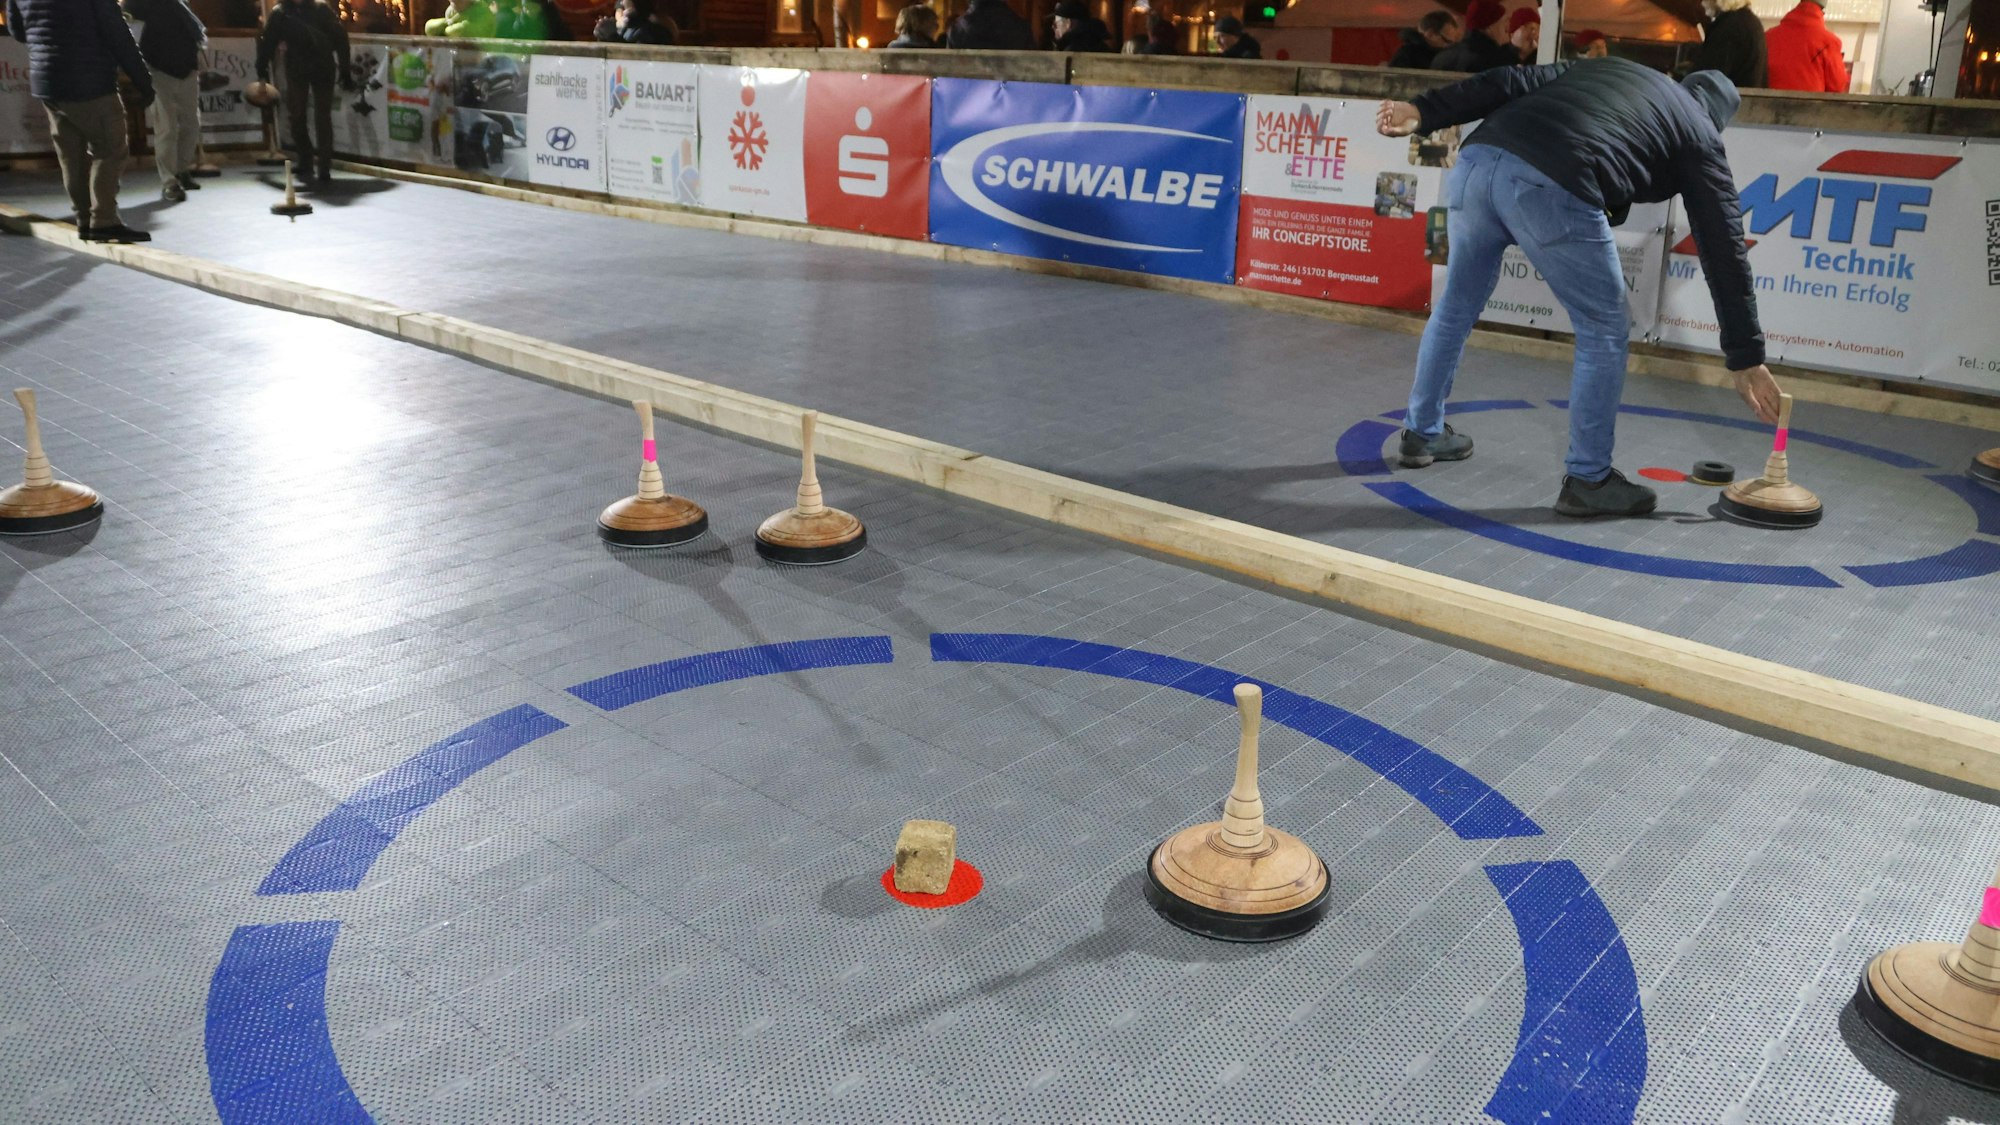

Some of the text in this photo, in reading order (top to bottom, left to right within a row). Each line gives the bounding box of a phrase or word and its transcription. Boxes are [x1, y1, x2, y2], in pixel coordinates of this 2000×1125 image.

[535, 71, 588, 89] stahlhacke
[556, 86, 588, 100] werke
[635, 81, 696, 103] BAUART
[1256, 110, 1320, 134] MANN
[1255, 131, 1348, 158] SCHETTE
[536, 153, 589, 171] HYUNDAI
[981, 155, 1224, 210] SCHWALBE
[1252, 207, 1373, 229] MODE UND GENUSS UNTER EINEM
[1738, 172, 1933, 249] MTF
[1251, 226, 1371, 253] IHR CONCEPTSTORE.
[1282, 264, 1297, 274] 246
[1302, 267, 1326, 278] 51702
[1327, 270, 1379, 284] Bergneustadt
[1801, 245, 1916, 281] Technik
[1249, 271, 1303, 286] mannschette.de
[1667, 259, 1698, 280] Wir
[1782, 274, 1838, 299] Ihren
[1845, 282, 1912, 314] Erfolg
[1486, 301, 1554, 317] 02261/914909
[1834, 339, 1905, 360] Automation
[1957, 355, 1985, 370] Tel.:
